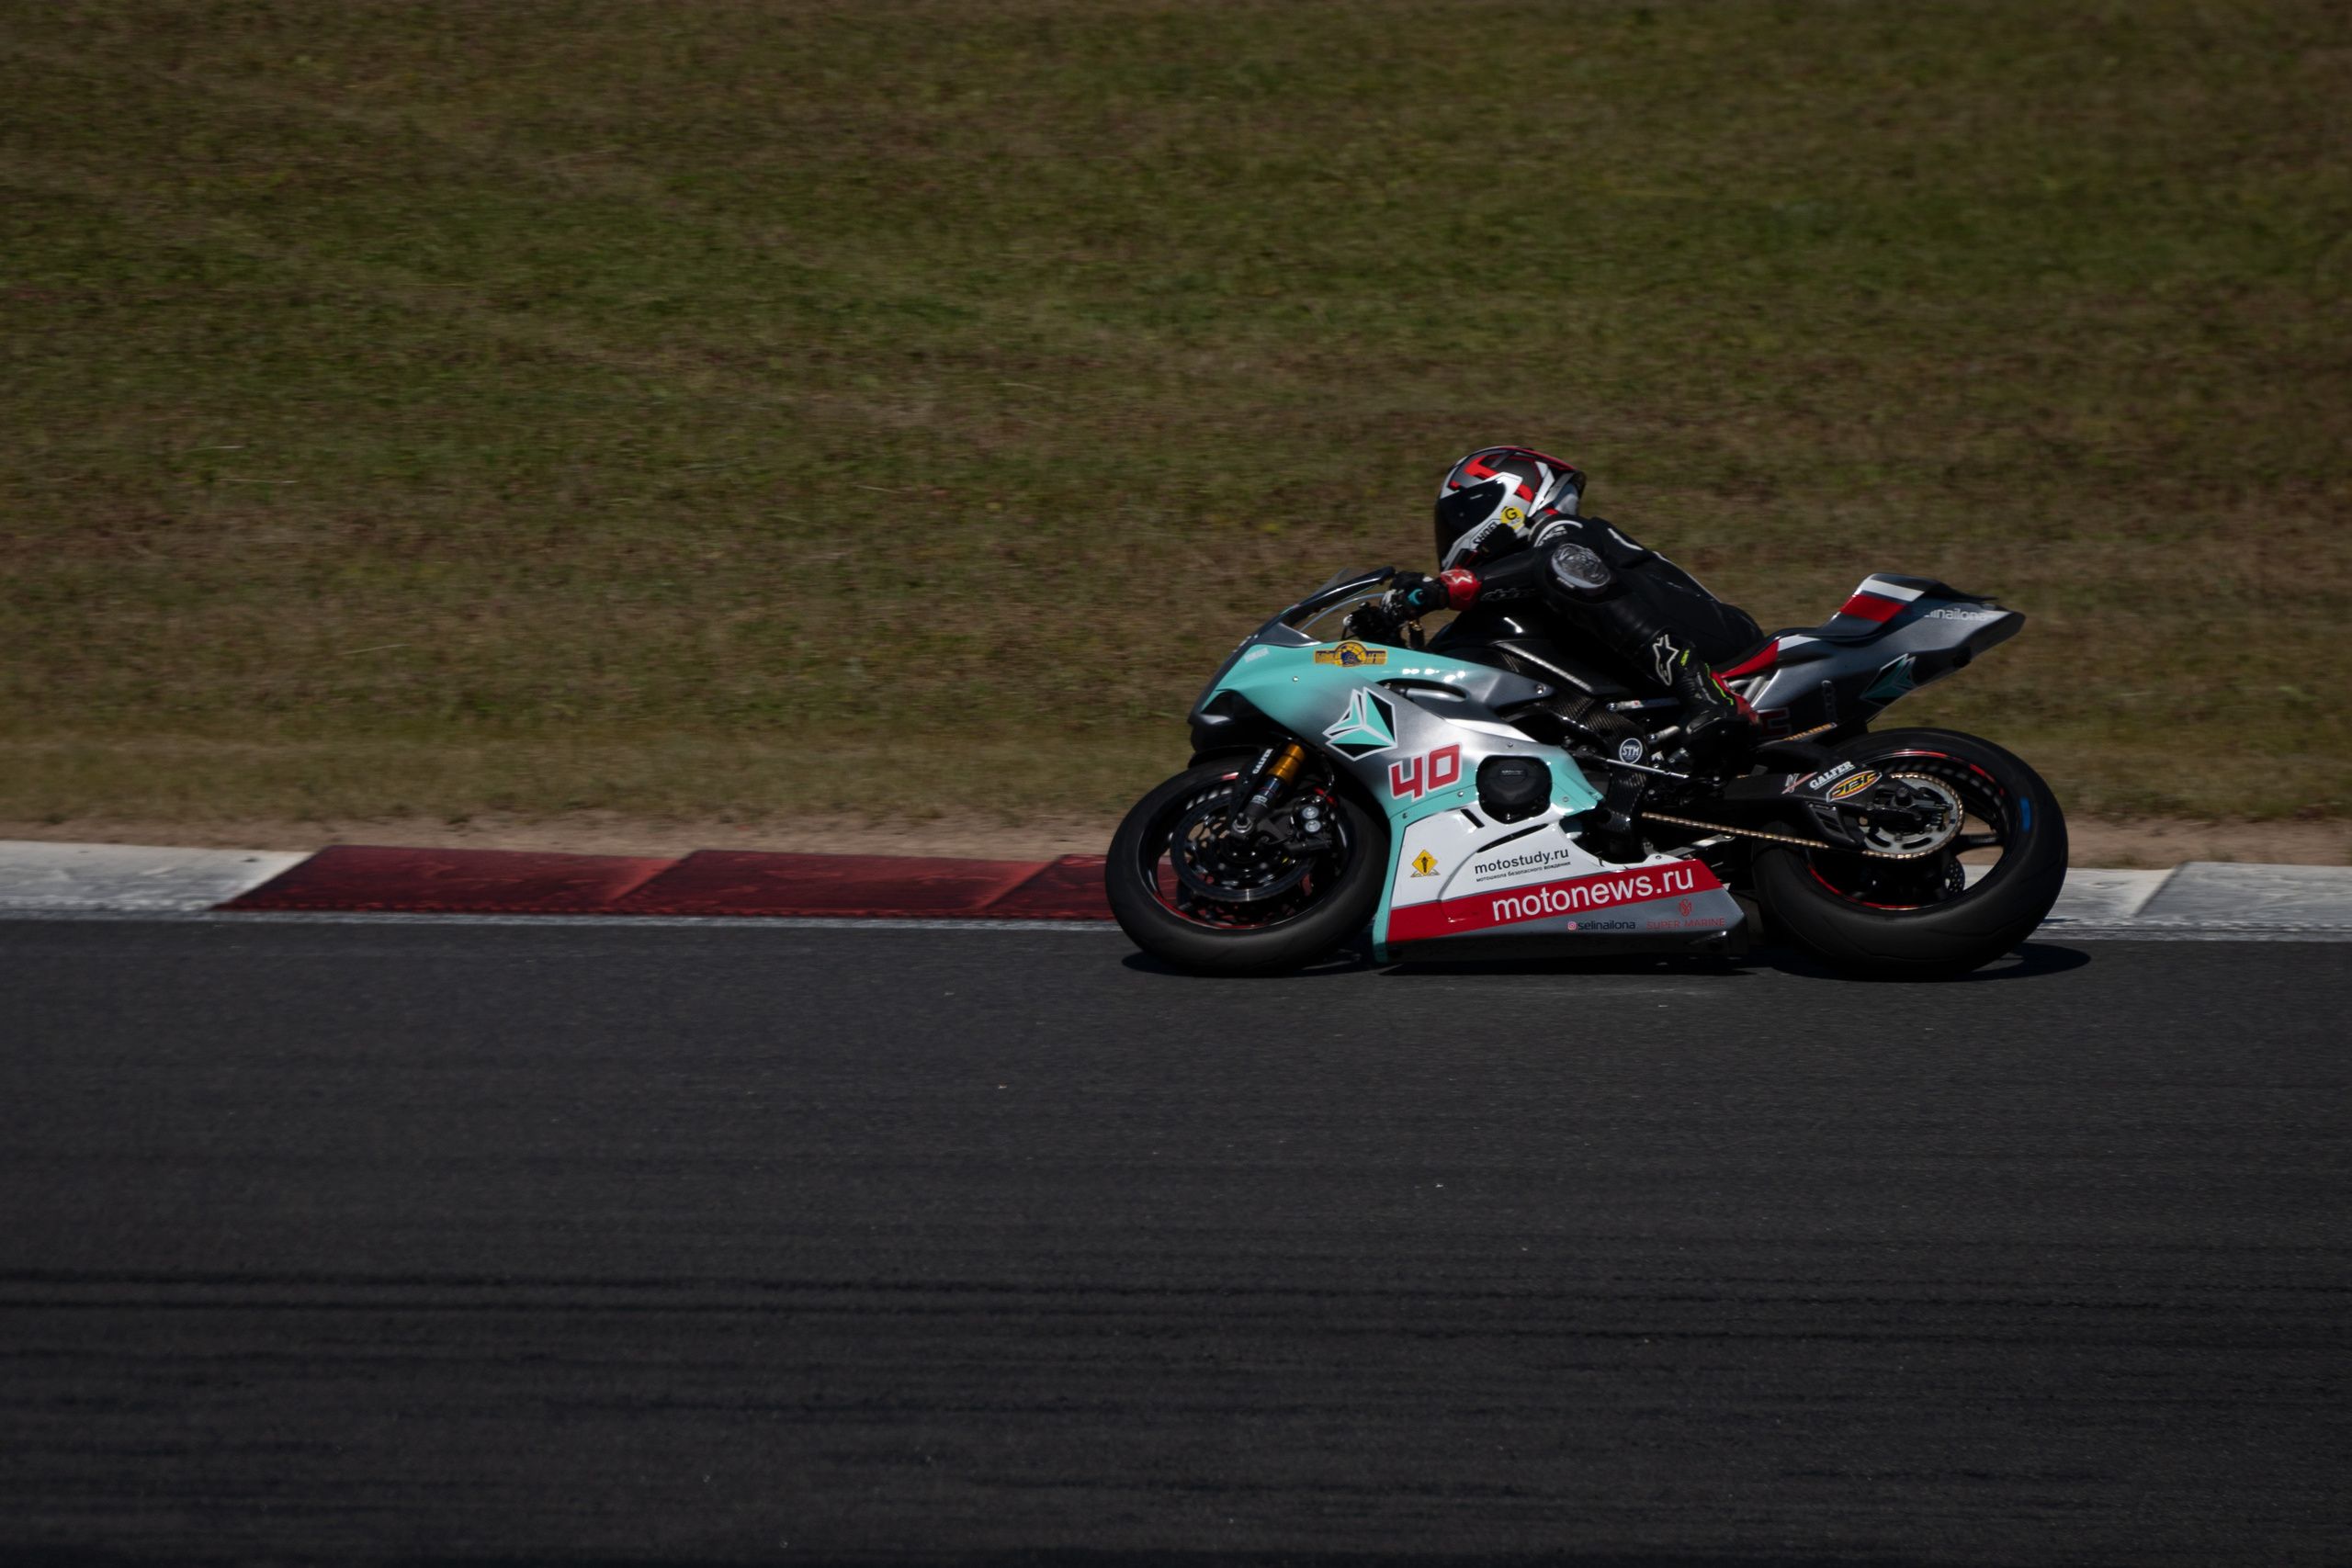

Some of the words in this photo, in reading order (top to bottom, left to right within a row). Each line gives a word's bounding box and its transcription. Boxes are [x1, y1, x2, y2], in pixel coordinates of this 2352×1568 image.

[1622, 745, 1640, 756] STM
[1390, 742, 1461, 801] 40
[1809, 761, 1855, 789] GALFER
[1475, 849, 1569, 874] motostudy.ru
[1508, 866, 1544, 877] безопасного
[1492, 868, 1694, 921] motonews.ru
[1577, 920, 1635, 931] selinailona
[1647, 920, 1680, 931] SUPER
[1684, 918, 1725, 928] MARINE
